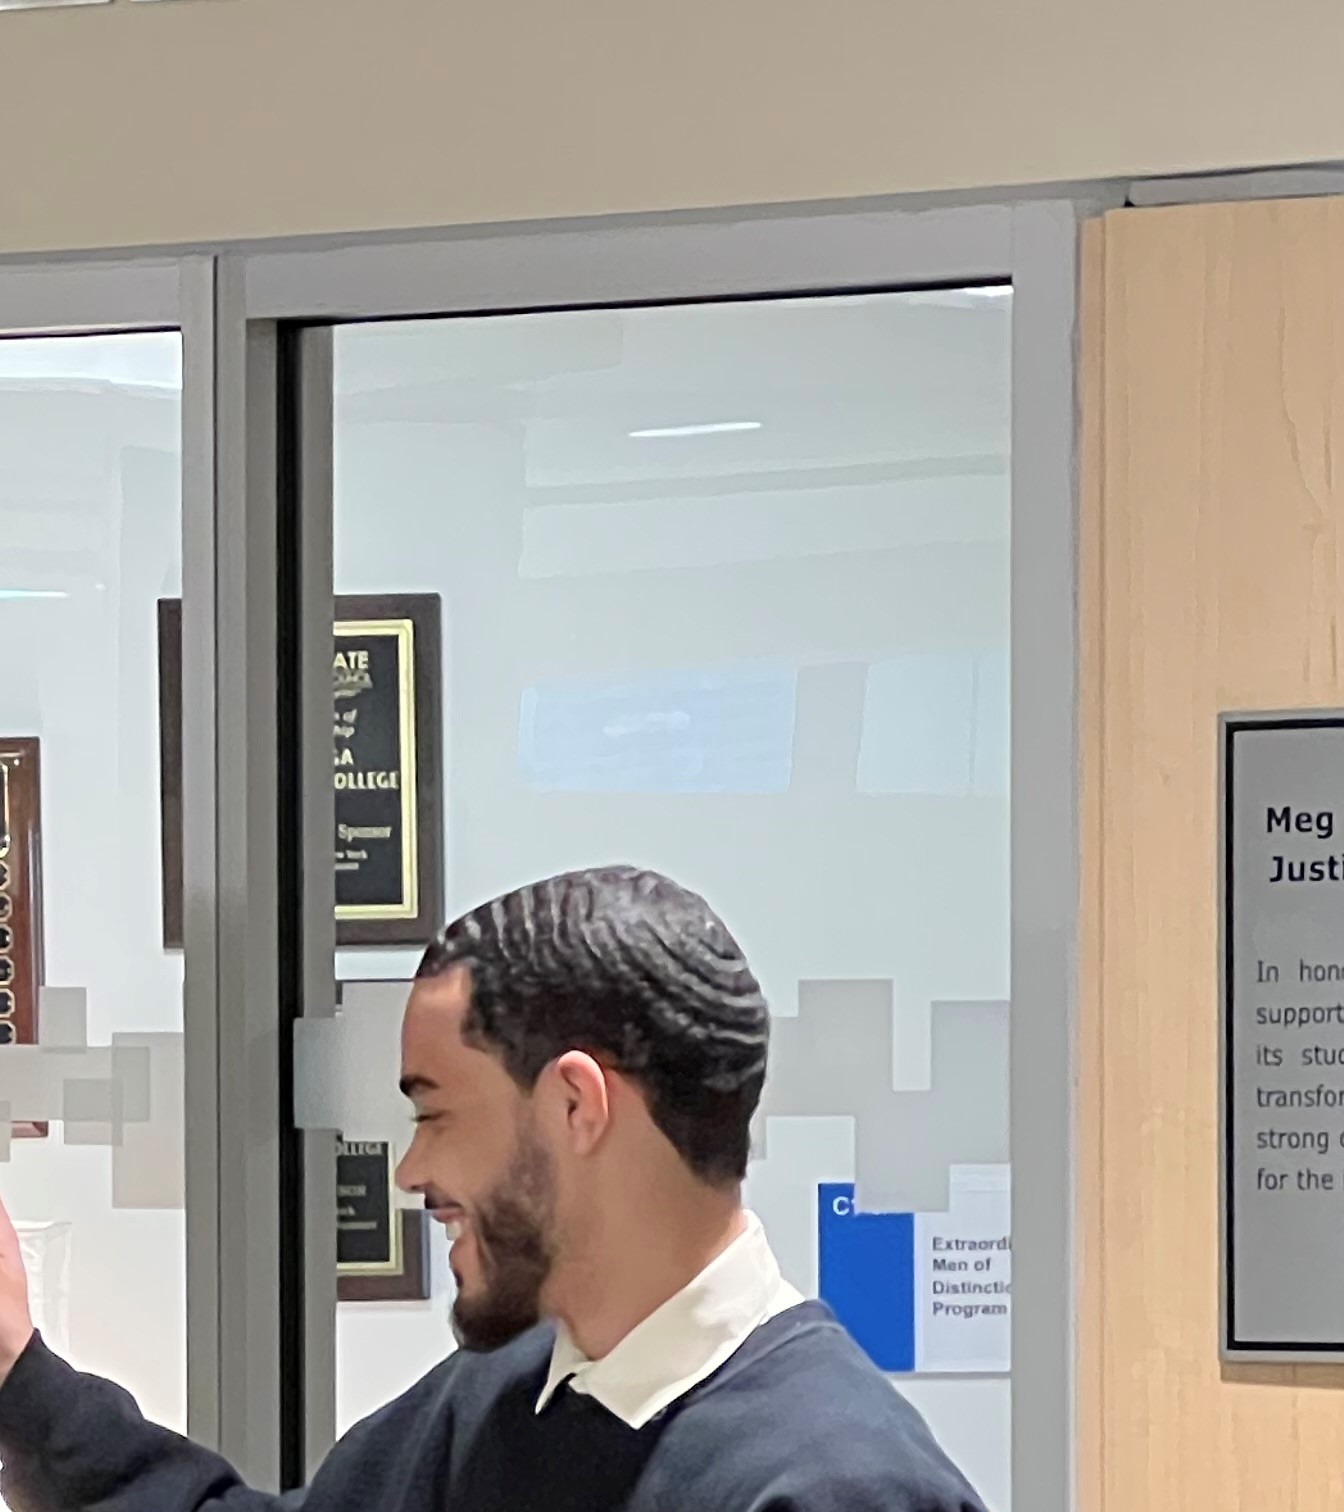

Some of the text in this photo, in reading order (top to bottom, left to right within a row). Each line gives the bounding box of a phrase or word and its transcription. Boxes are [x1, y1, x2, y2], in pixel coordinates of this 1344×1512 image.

[1267, 806, 1333, 839] Meg
[1256, 960, 1280, 982] In
[1256, 1045, 1283, 1066] its
[1256, 1129, 1329, 1154] strong
[1256, 1168, 1334, 1190] for the
[932, 1257, 991, 1271] Men of
[932, 1301, 1008, 1319] Program
